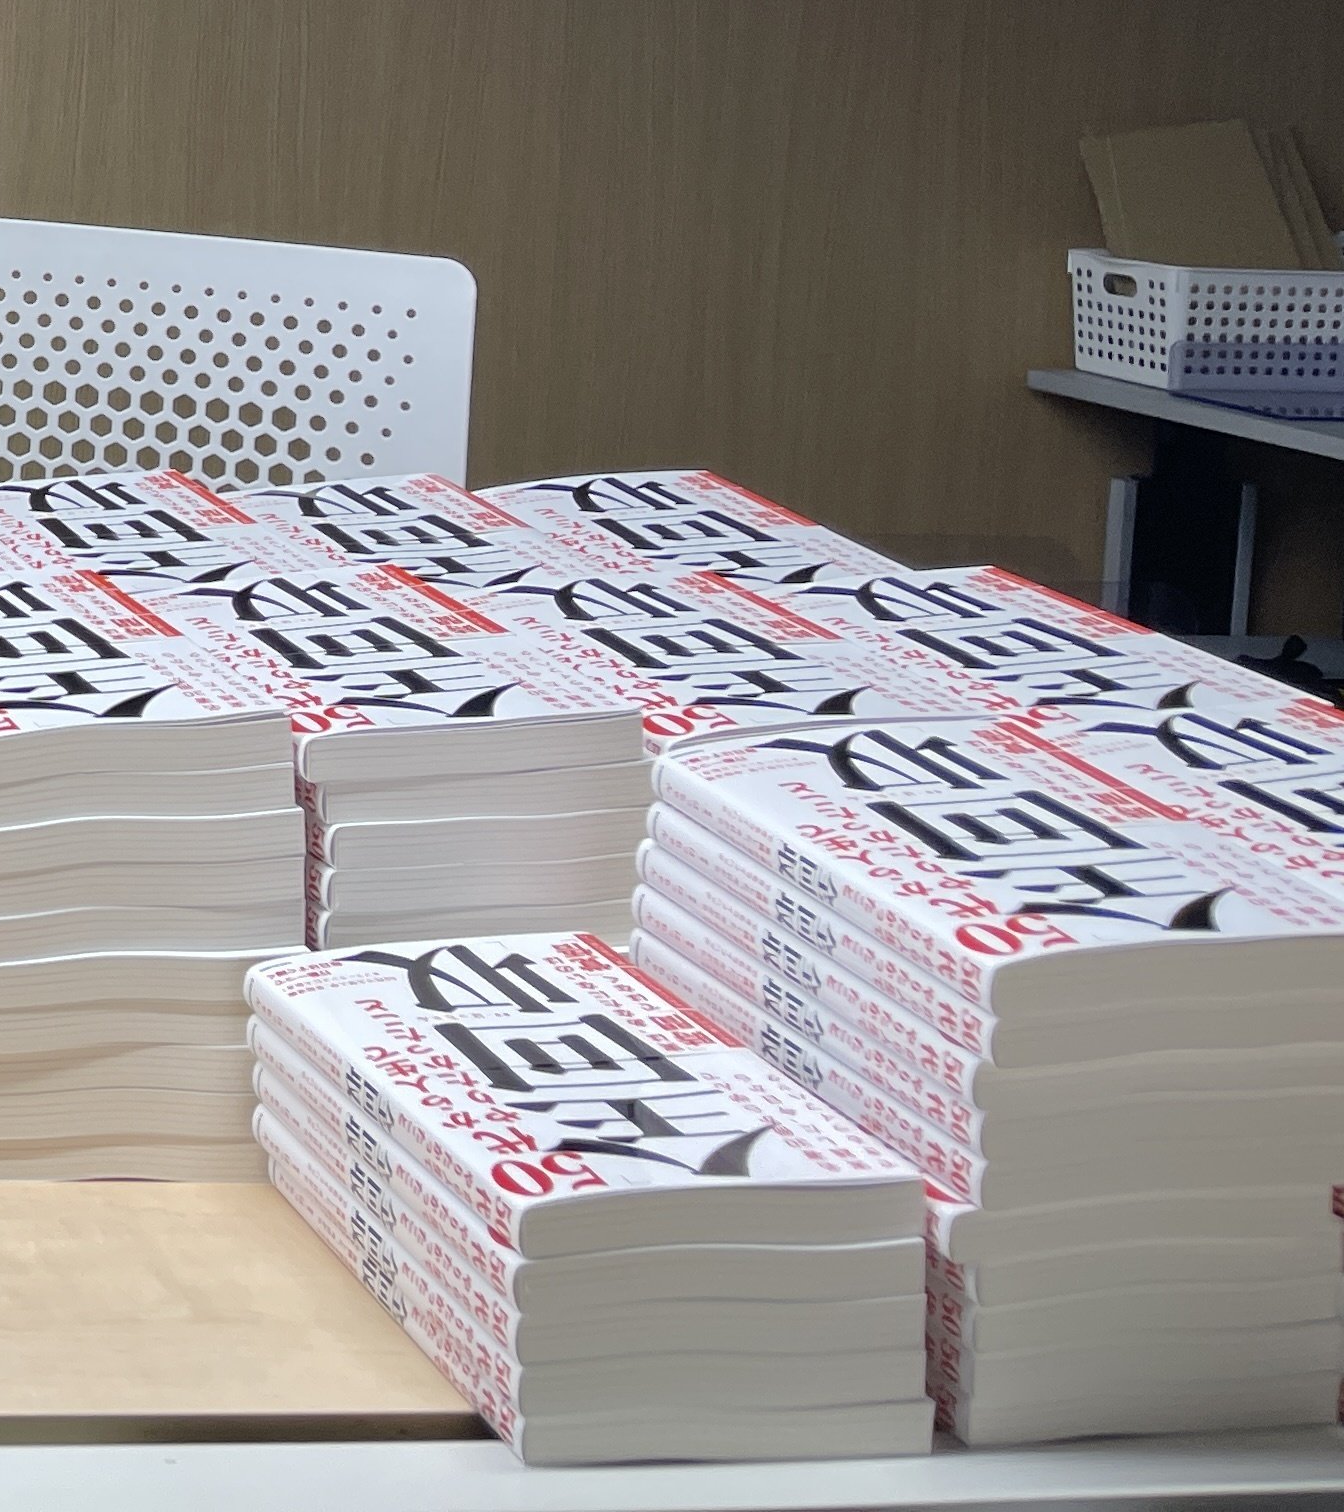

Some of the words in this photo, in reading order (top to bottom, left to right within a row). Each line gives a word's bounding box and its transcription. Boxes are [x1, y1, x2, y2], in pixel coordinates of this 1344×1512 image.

[248, 484, 545, 588] 全回収
[521, 478, 835, 583] 全回収
[178, 578, 525, 716] 全回収
[498, 578, 873, 714] 全回収
[794, 577, 1201, 710] 全回収
[752, 730, 1238, 931] 全回収
[779, 780, 976, 889] やりたかったこと
[776, 843, 838, 907] 全回収
[775, 892, 837, 957] 全回収
[762, 931, 822, 995] 全回収
[762, 977, 824, 1042] 全回収
[334, 945, 778, 1177] 全回収
[355, 999, 522, 1122] やりたかったこと
[760, 1024, 824, 1089] 全回収
[345, 1064, 395, 1136] 全回収
[345, 1112, 394, 1185] 全回収
[349, 1162, 397, 1235] 全回収
[350, 1209, 399, 1279] 全回収
[361, 1258, 408, 1328] 全回収
